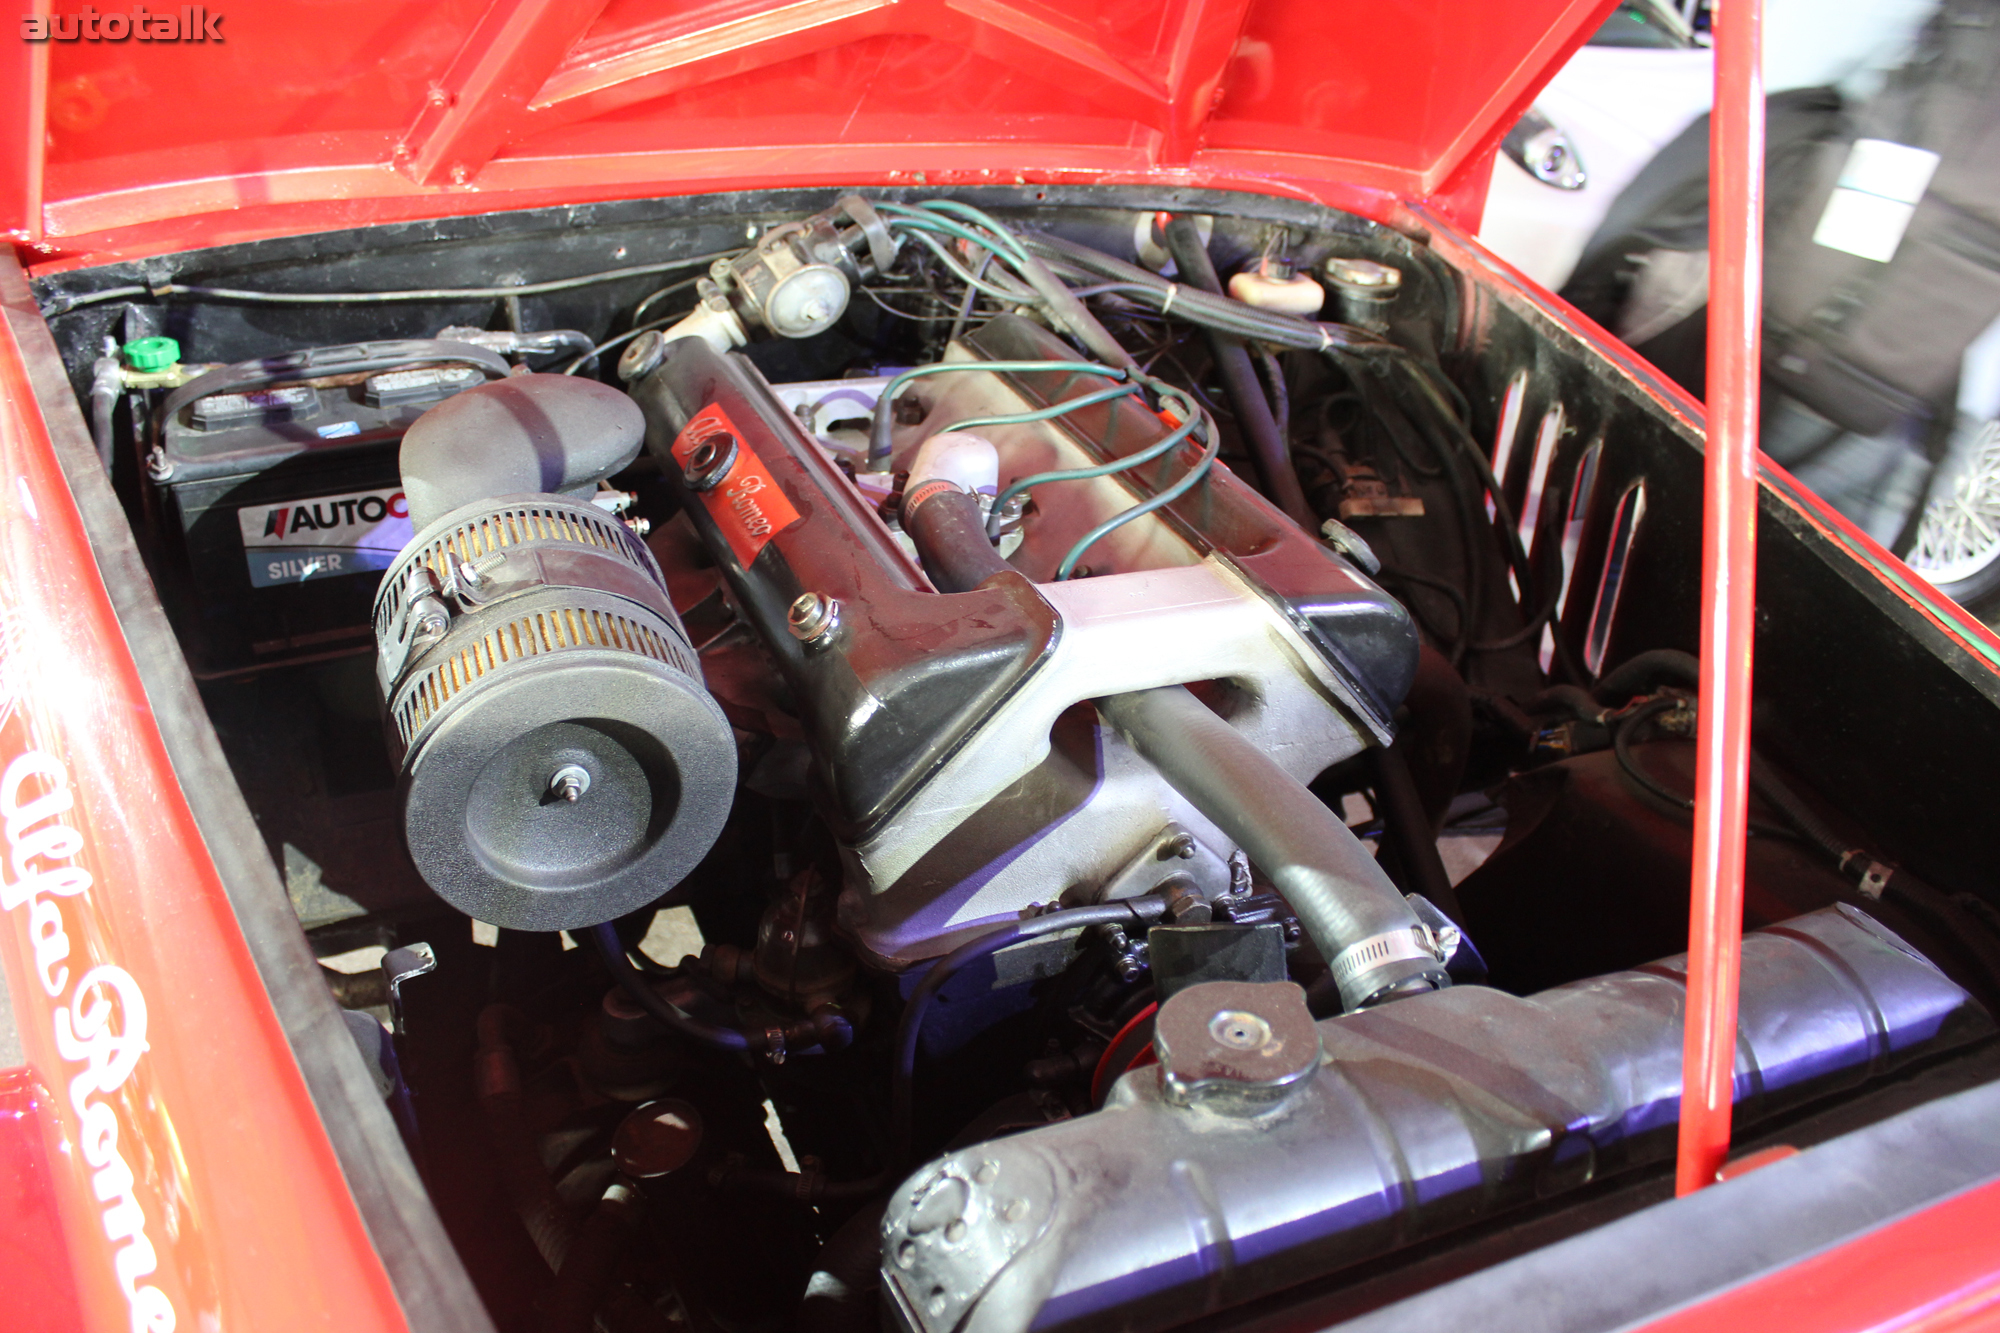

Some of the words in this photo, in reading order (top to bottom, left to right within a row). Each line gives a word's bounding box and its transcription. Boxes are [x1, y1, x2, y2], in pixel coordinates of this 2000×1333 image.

[726, 475, 773, 537] Romeo
[268, 553, 343, 580] SILVER
[0, 750, 93, 997] Alfa
